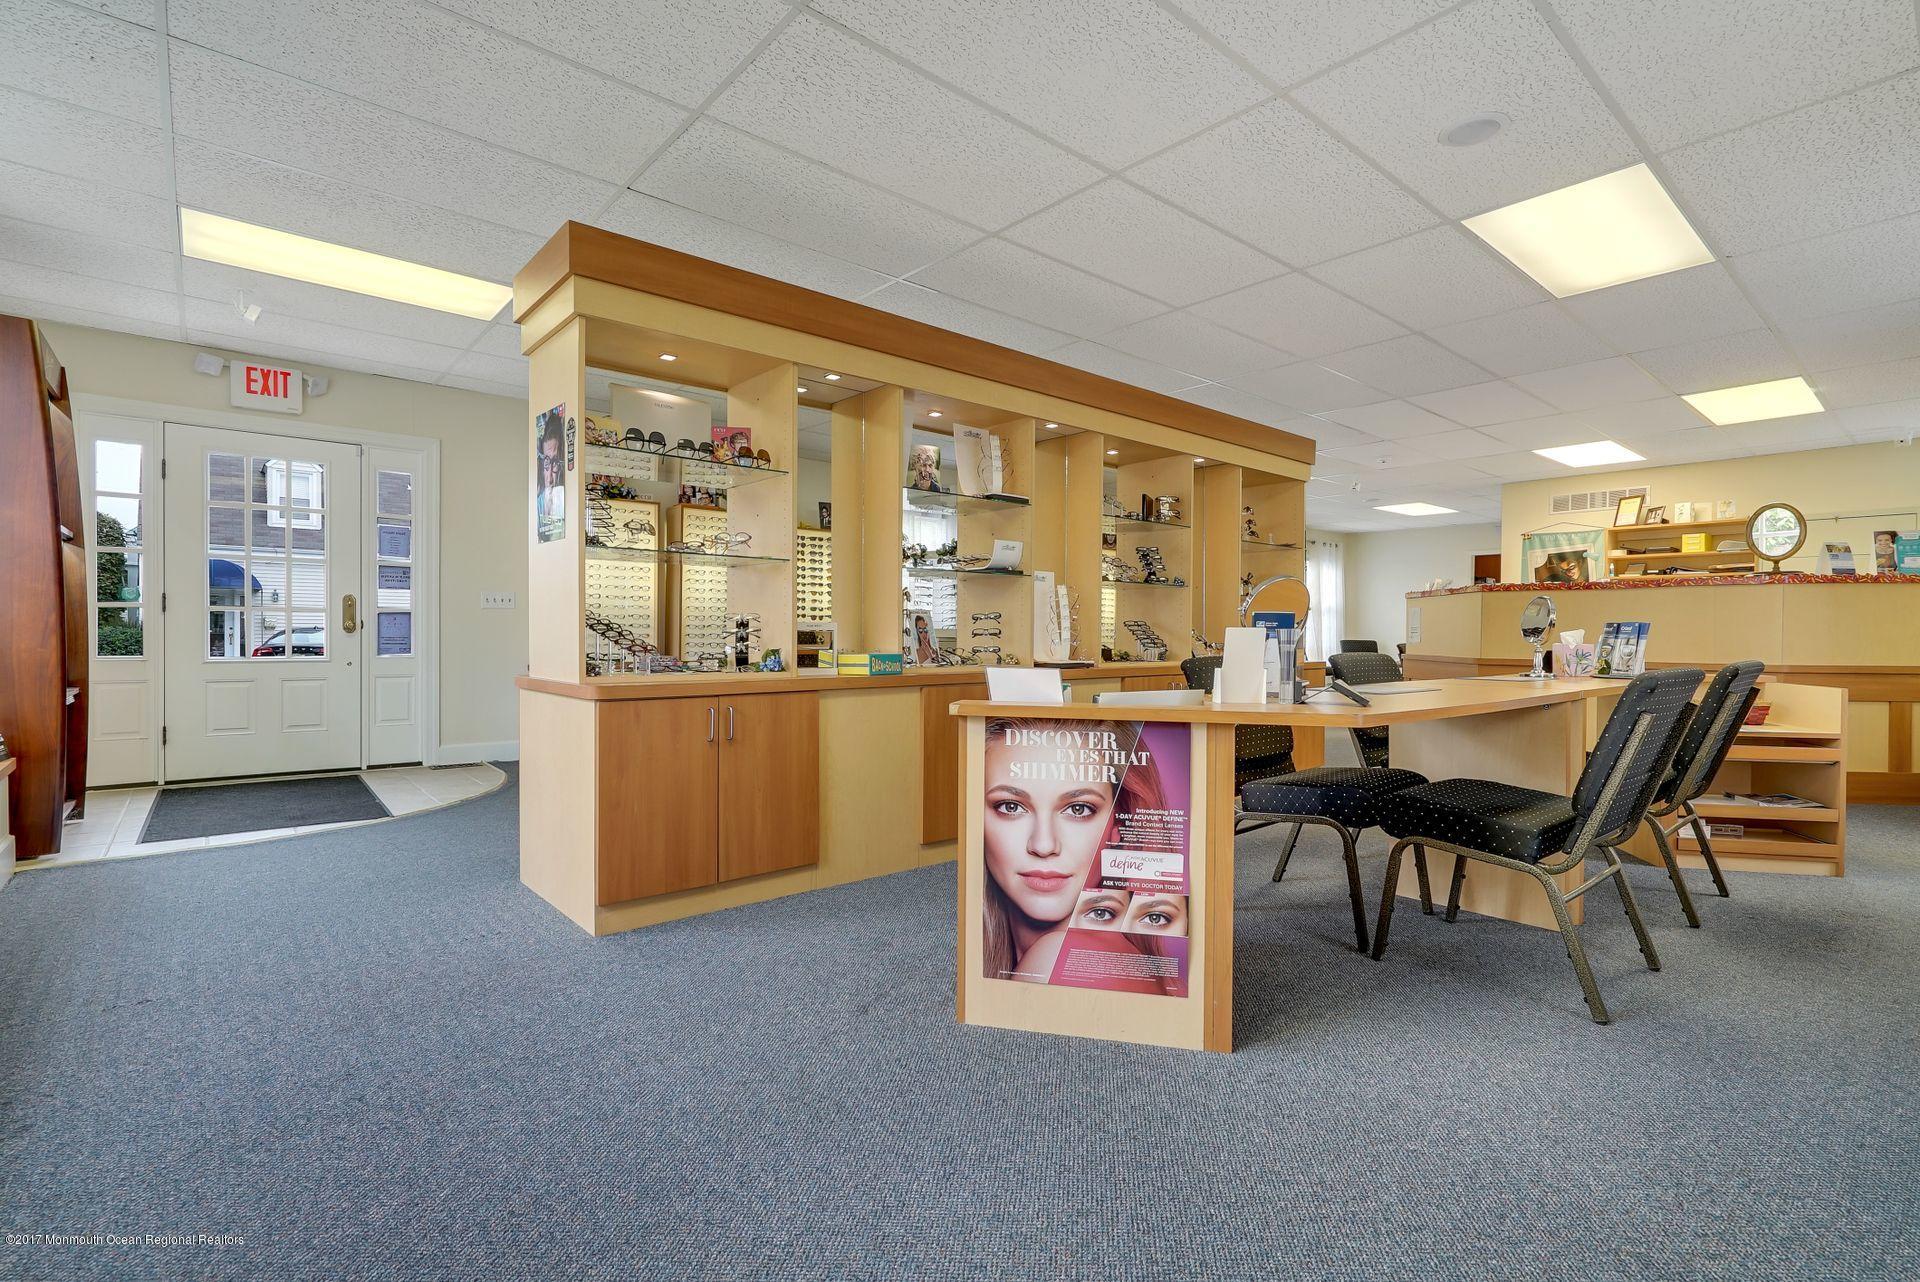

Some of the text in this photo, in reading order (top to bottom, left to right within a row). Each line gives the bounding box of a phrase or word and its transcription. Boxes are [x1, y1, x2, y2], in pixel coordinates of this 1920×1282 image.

[246, 366, 291, 399] EXIT
[1004, 728, 1119, 751] DISCOVER
[1056, 748, 1150, 766] EYES THAT
[1009, 761, 1118, 784] SHIMMER
[1135, 808, 1169, 816] Introducing
[1109, 855, 1144, 874] define
